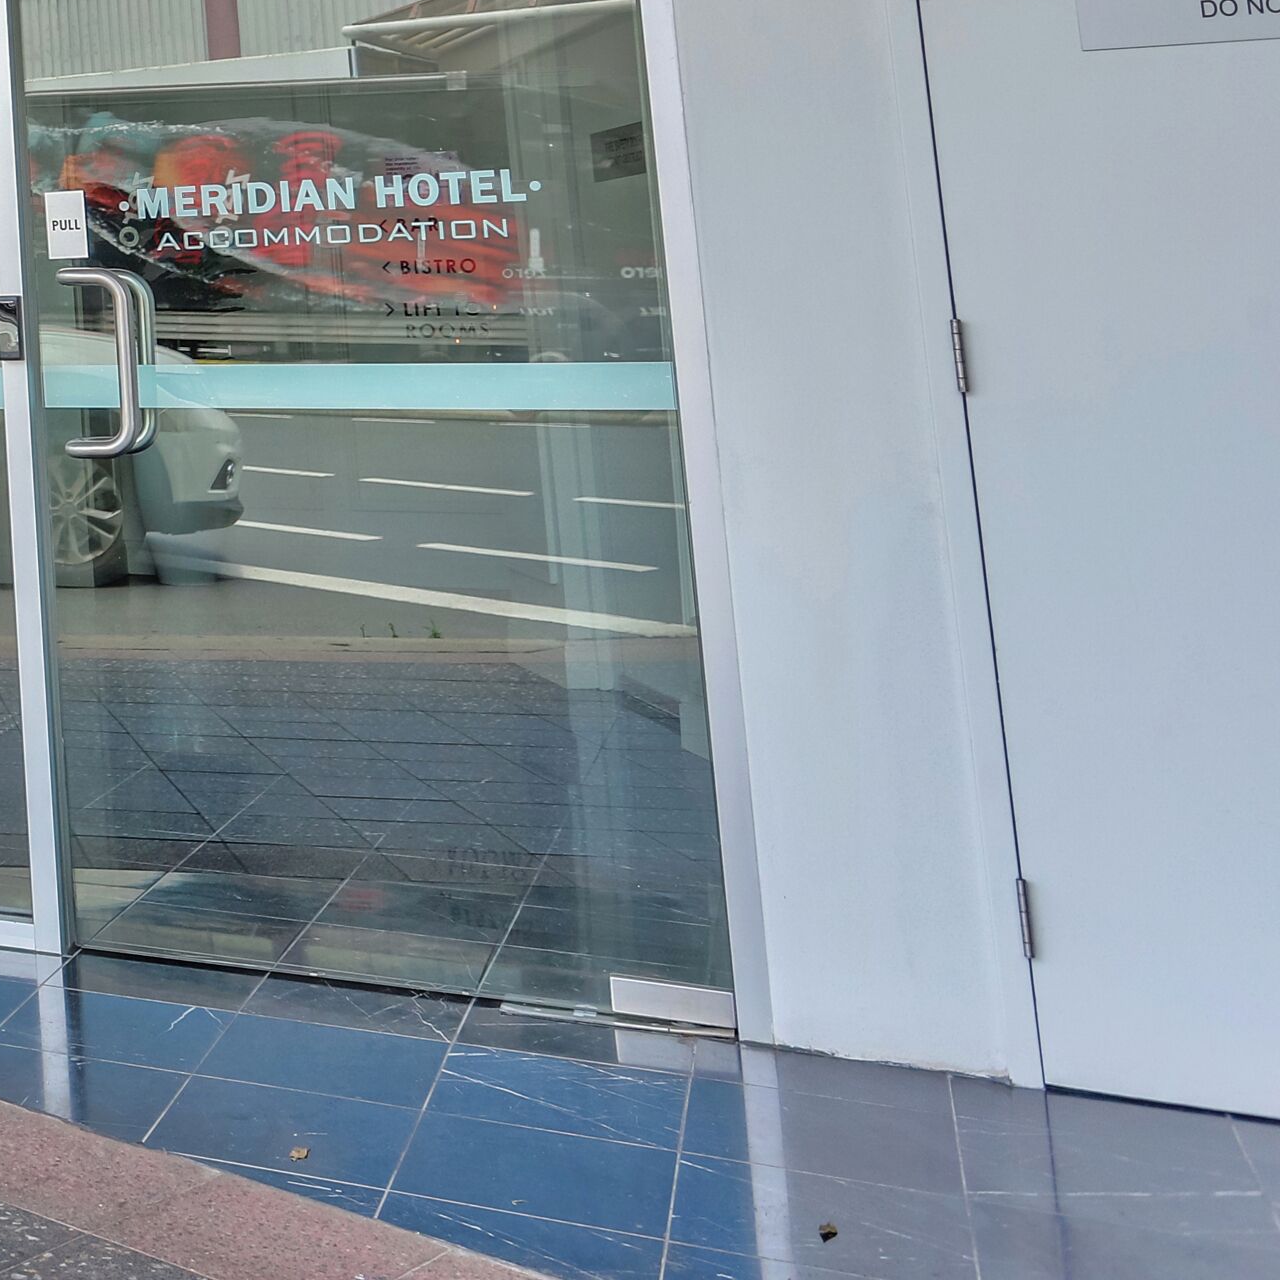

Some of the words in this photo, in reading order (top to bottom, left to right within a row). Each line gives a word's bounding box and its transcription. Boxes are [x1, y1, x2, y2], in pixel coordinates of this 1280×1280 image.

[136, 175, 357, 220] MERIDIAN
[374, 168, 528, 208] HOTEL
[51, 218, 82, 232] PULL
[156, 218, 509, 251] ACCOMMODATION
[399, 258, 477, 274] BISTRO
[405, 322, 490, 338] ROOMS
